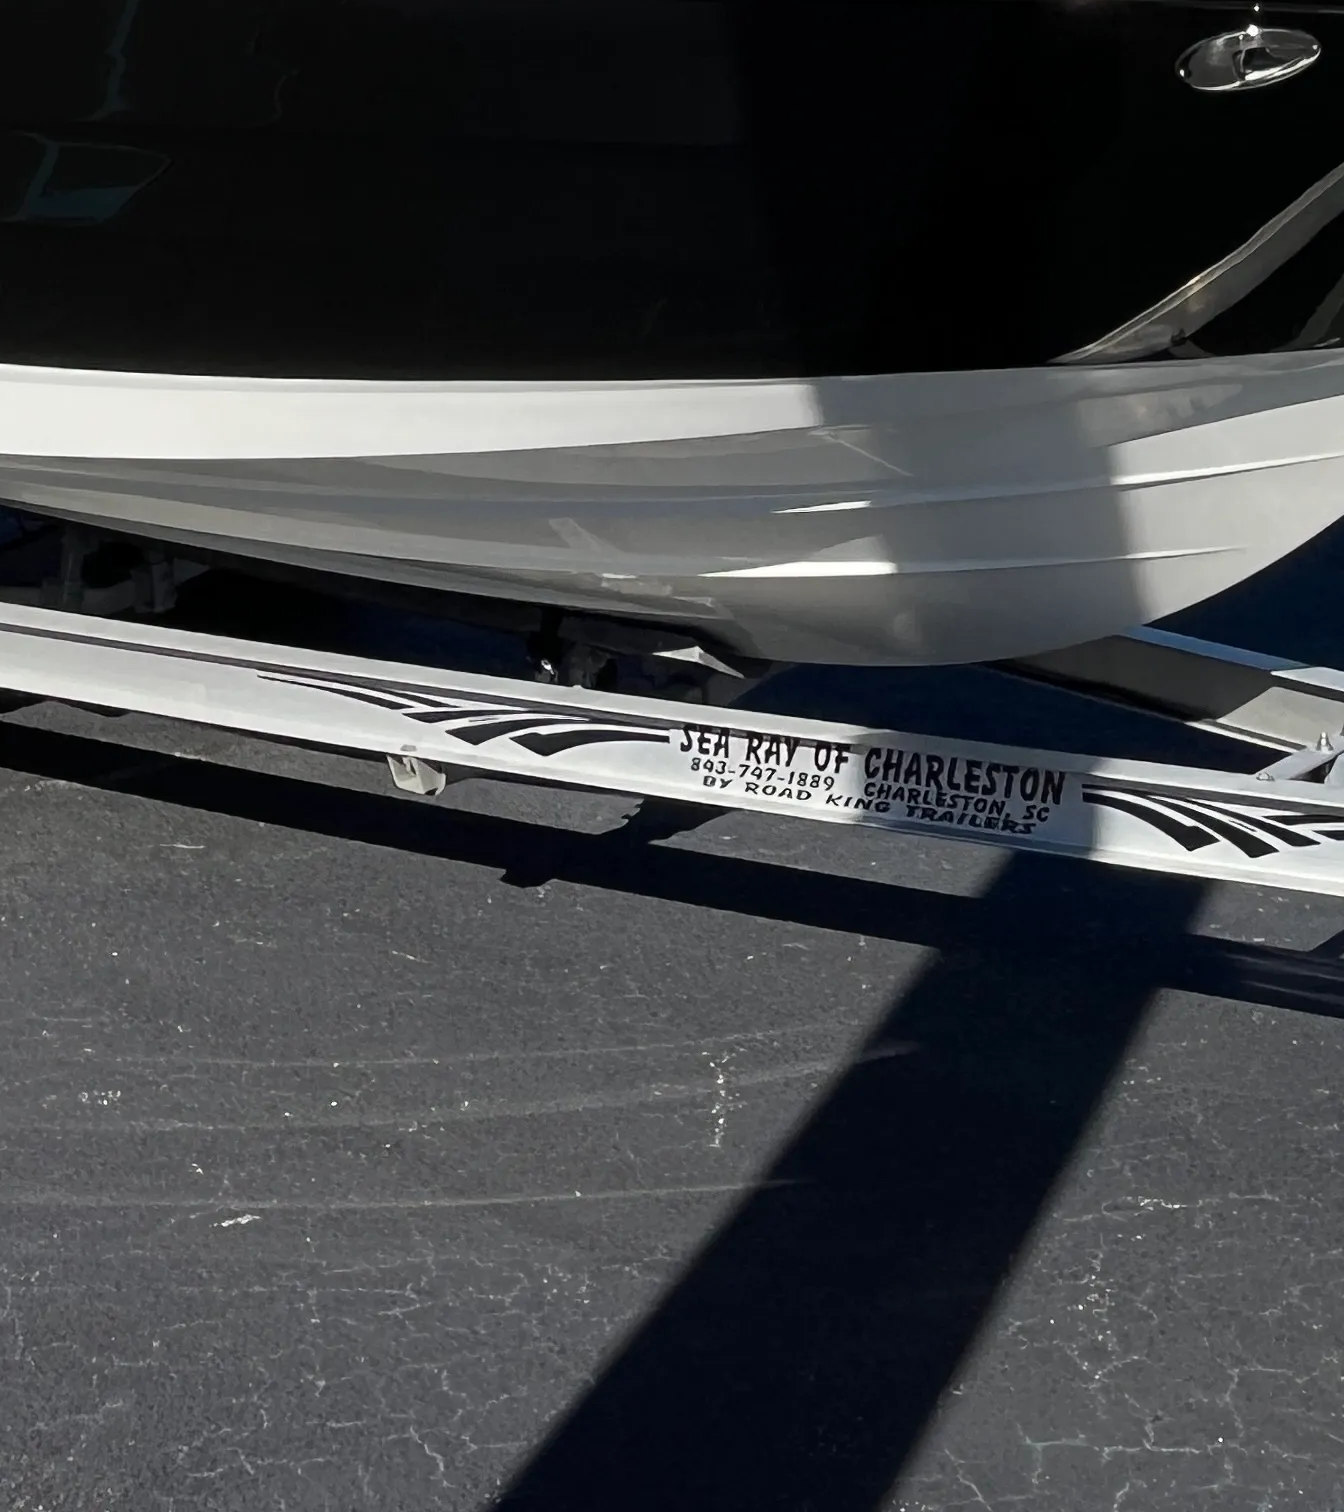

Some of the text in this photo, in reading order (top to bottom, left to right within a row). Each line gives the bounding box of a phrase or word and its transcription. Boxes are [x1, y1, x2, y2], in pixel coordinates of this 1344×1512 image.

[680, 723, 1066, 806] SEA RAY OF CHARLESTON
[690, 757, 835, 791] 843-747-1889
[1022, 804, 1050, 823] SC
[703, 775, 1037, 835] BY ROAD KING TRAILERS
